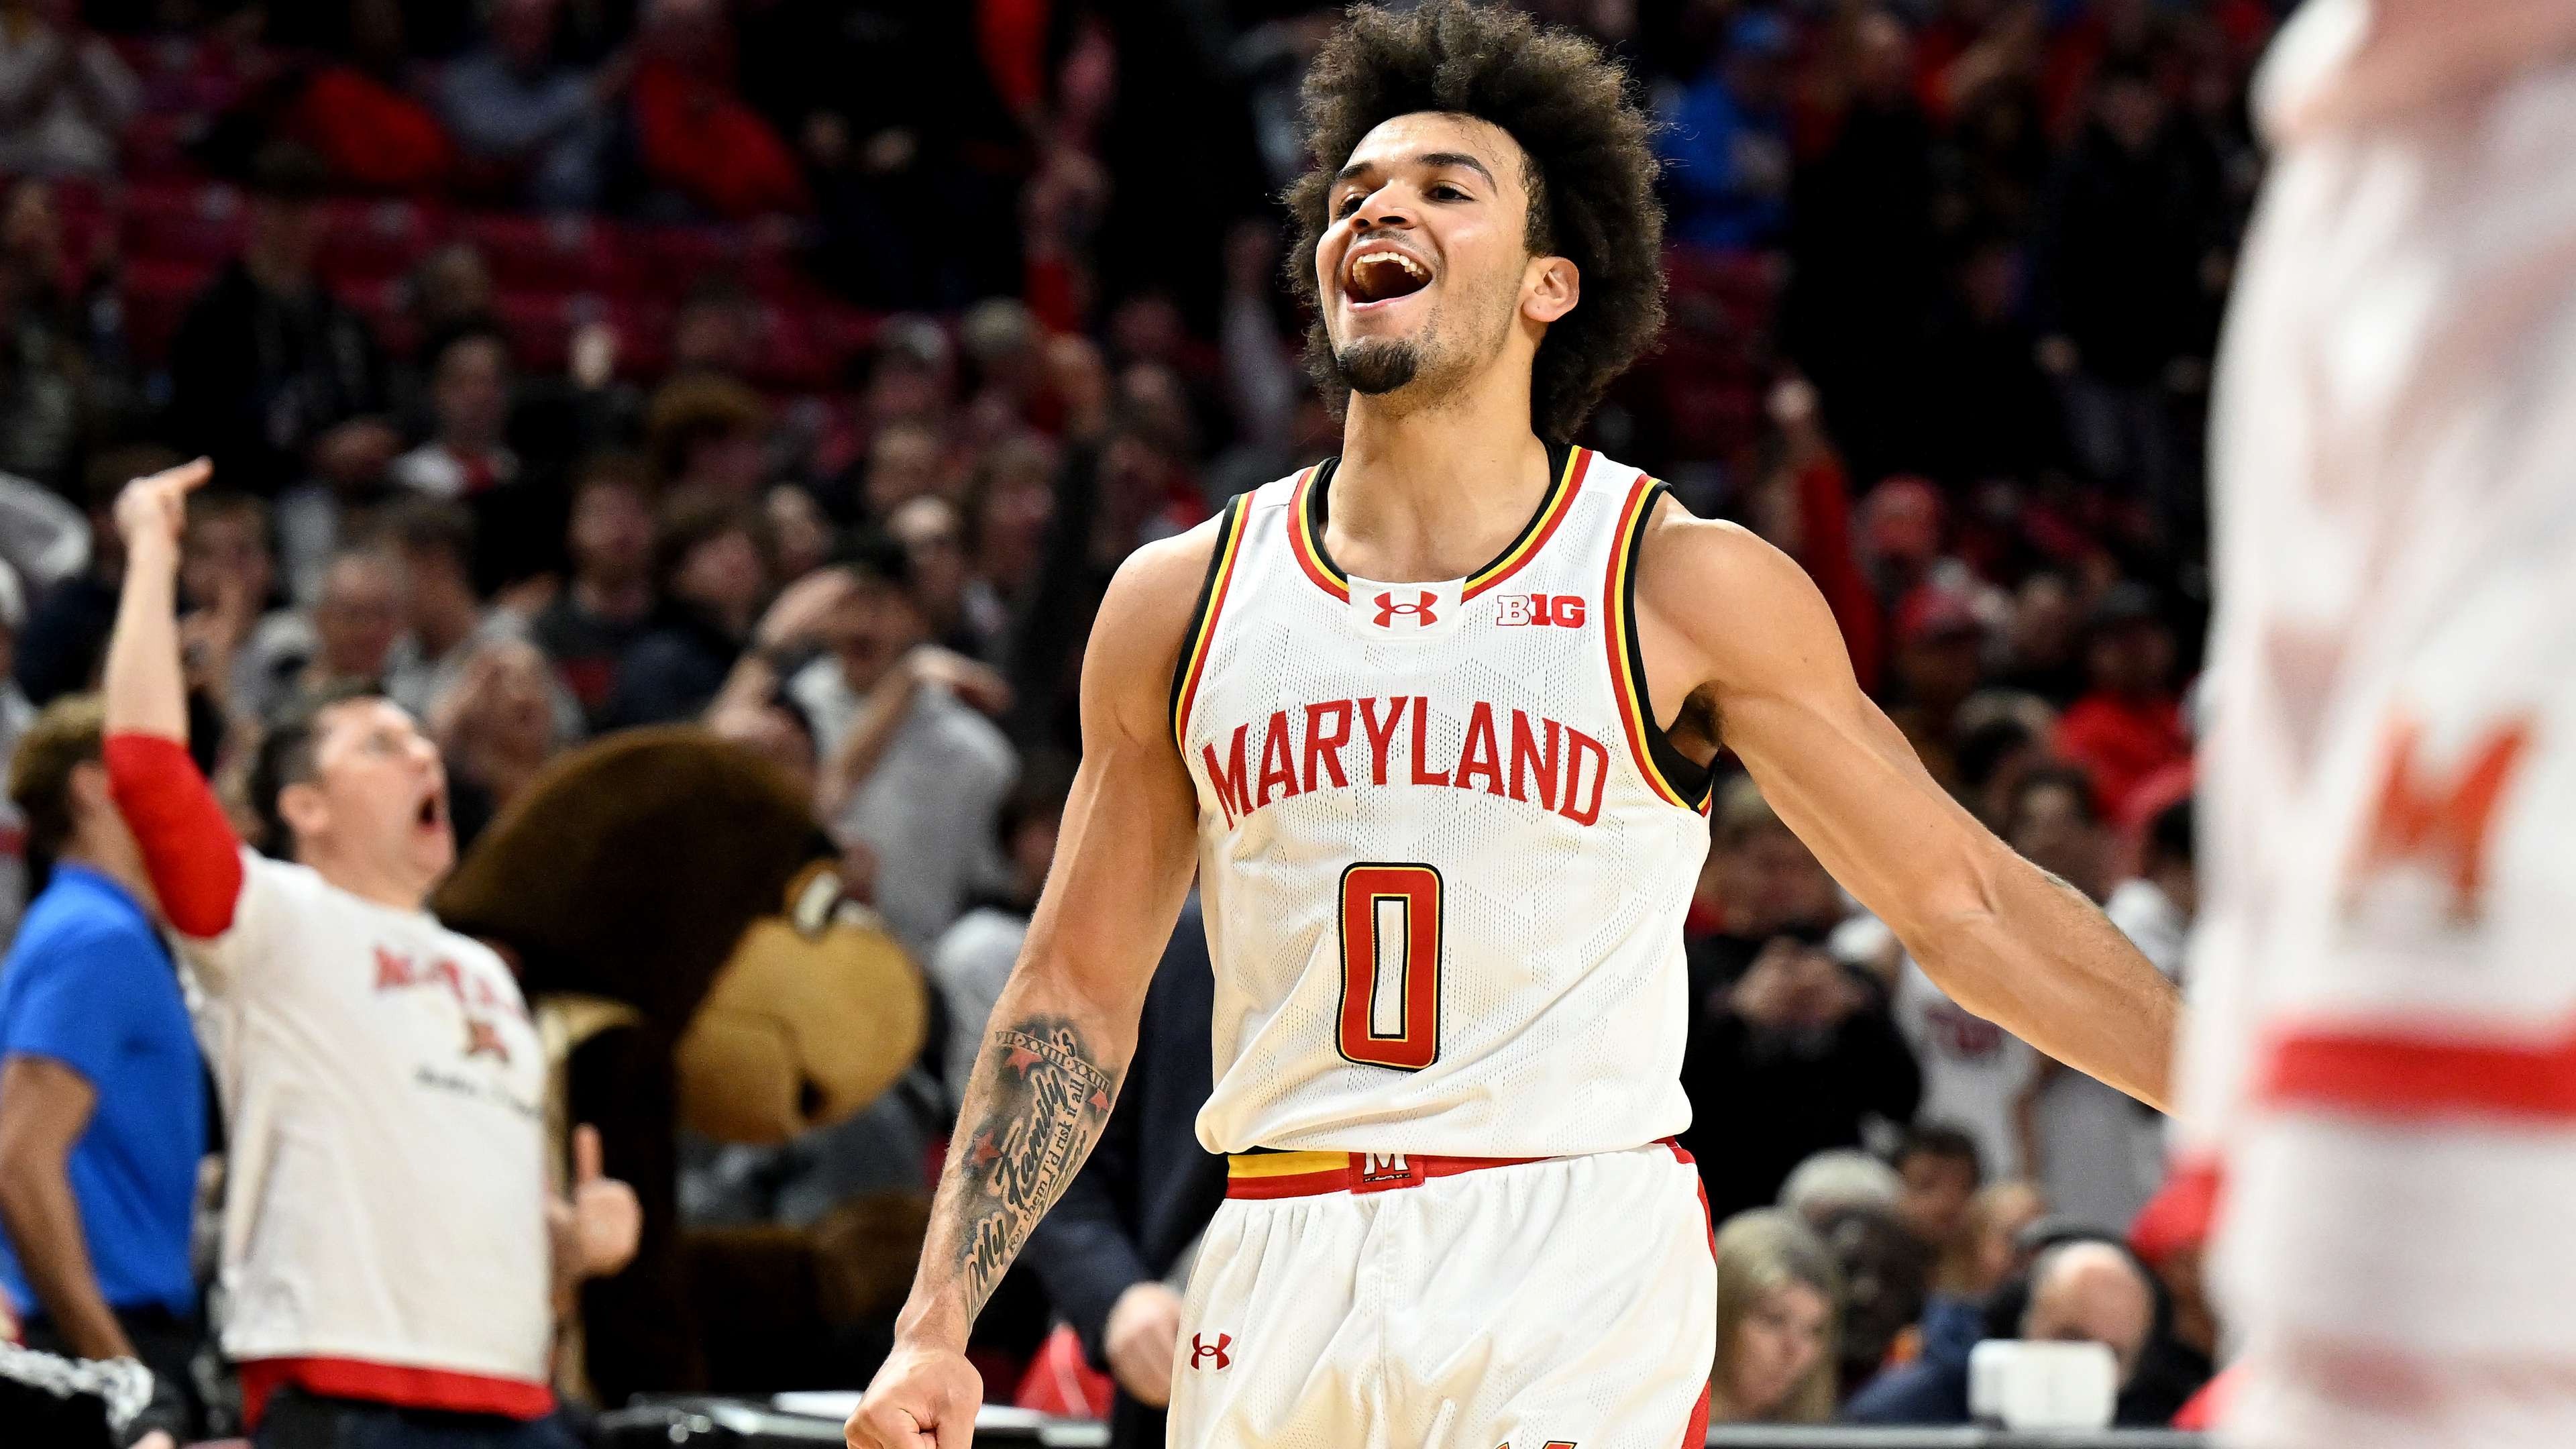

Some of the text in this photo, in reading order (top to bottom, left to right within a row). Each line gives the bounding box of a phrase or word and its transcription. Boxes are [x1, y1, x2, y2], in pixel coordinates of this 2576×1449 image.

[1202, 696, 1609, 831] MARYLAND
[1336, 861, 1444, 1073] 0
[1023, 1181, 1048, 1222] them
[1042, 1150, 1061, 1178] I'd
[1055, 1120, 1073, 1150] risk
[1069, 1078, 1085, 1104] all
[969, 1218, 1006, 1320] My
